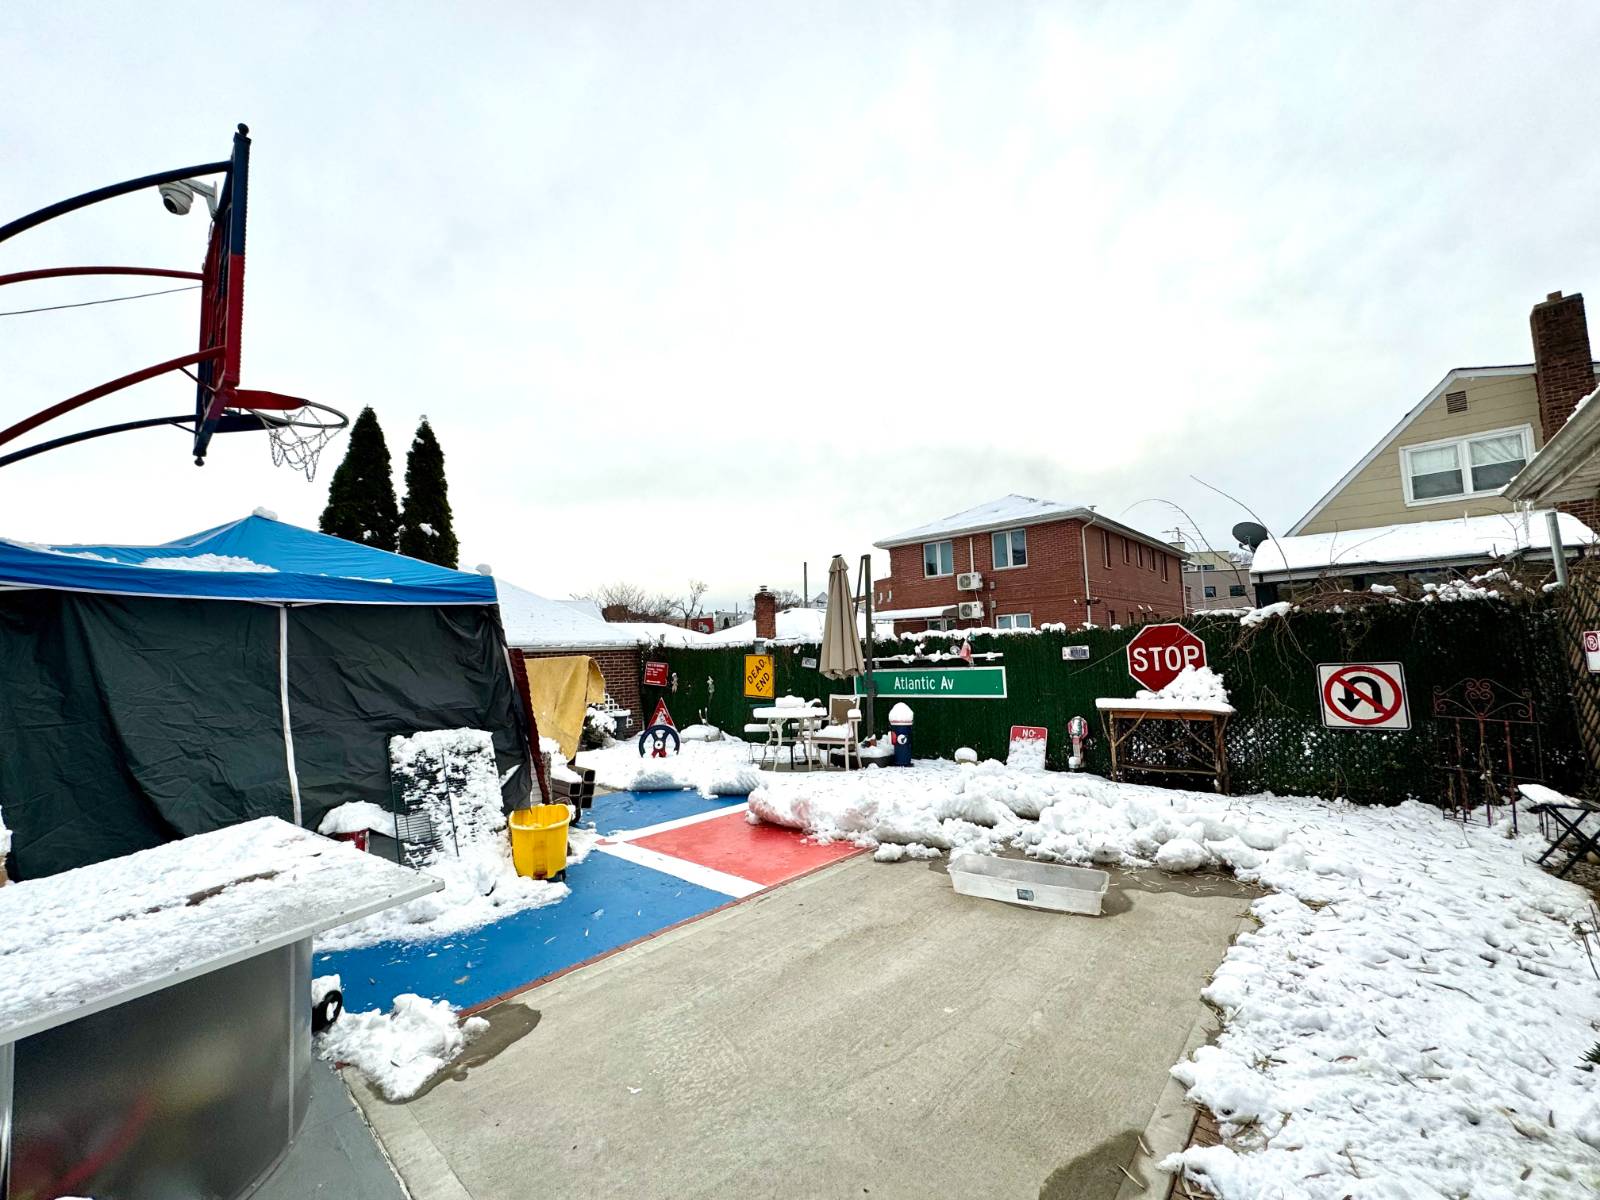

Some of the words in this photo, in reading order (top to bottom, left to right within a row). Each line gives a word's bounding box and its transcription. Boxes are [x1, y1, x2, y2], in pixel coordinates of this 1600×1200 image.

[1133, 645, 1200, 672] STOP
[747, 659, 766, 684] DEAD
[755, 672, 770, 692] END
[894, 676, 936, 690] Atlantic
[940, 675, 954, 690] Av
[1022, 729, 1035, 737] NO
